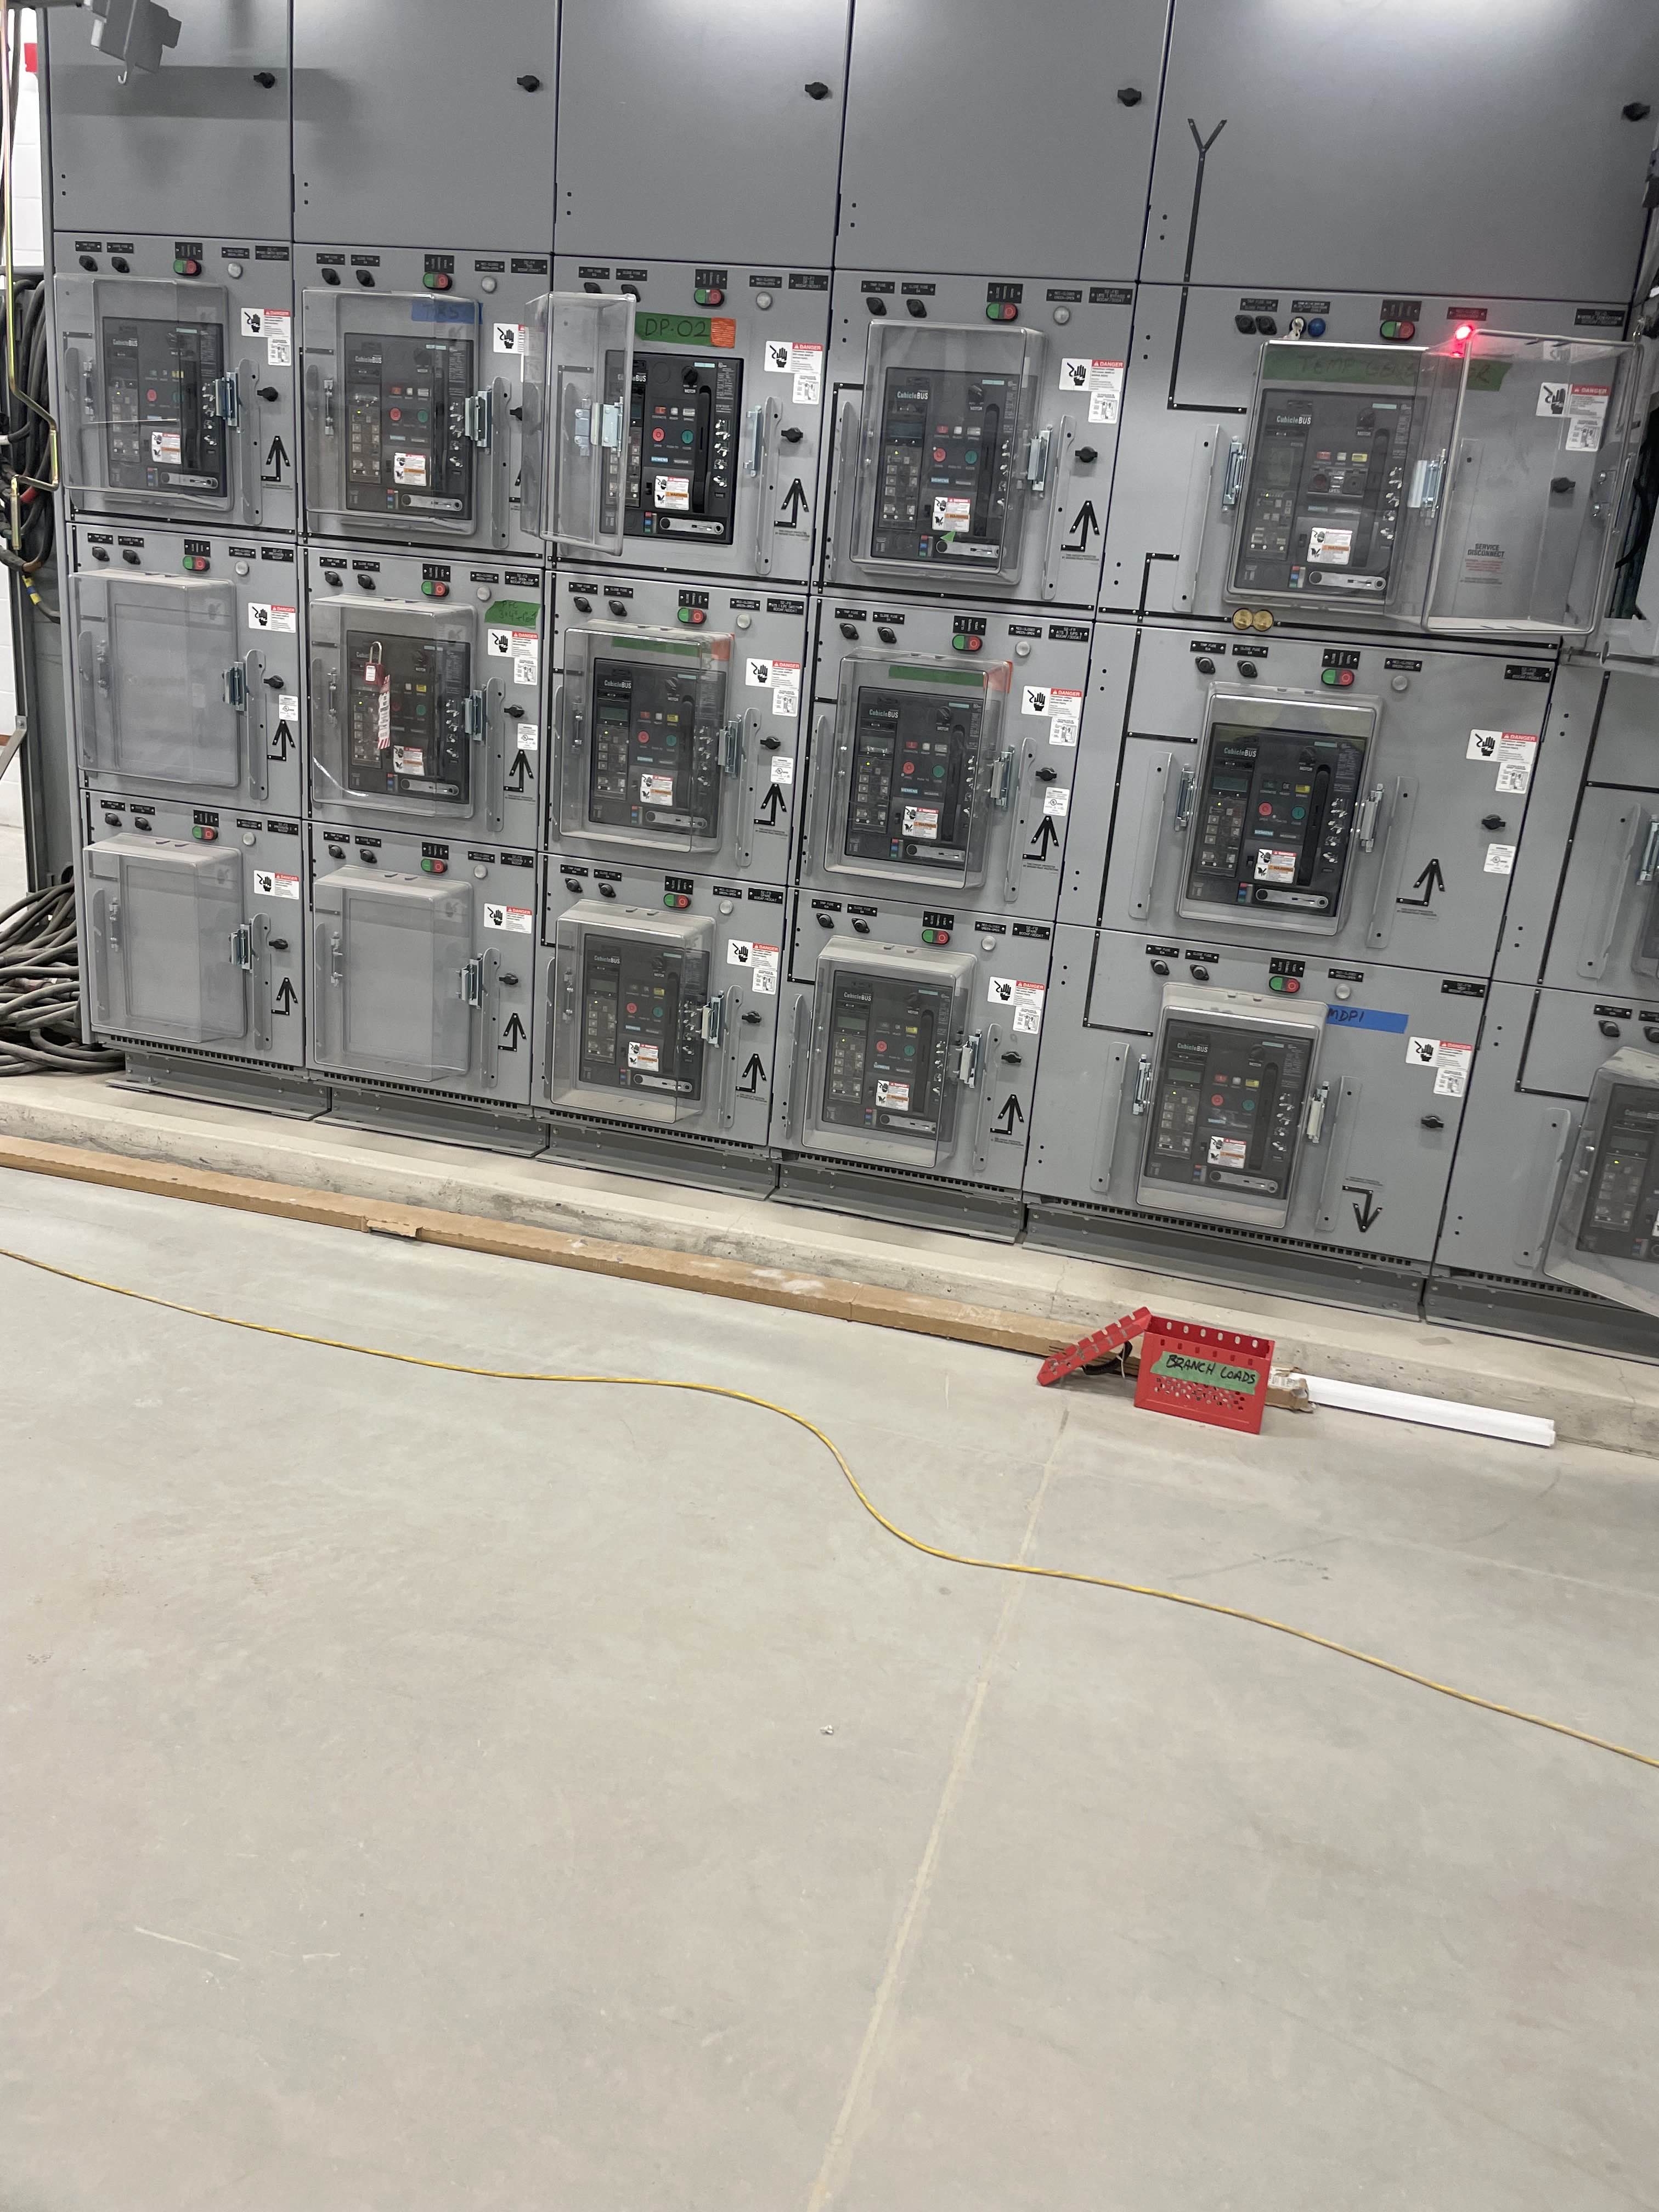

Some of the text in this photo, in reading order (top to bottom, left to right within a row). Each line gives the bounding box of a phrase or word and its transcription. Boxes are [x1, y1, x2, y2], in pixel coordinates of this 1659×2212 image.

[897, 391, 928, 400] CubicleBUS
[1277, 415, 1311, 425] CubicleBUS
[1475, 543, 1499, 551] SERVICE
[1467, 549, 1505, 557] DISCONNECT
[869, 709, 899, 719] CubicleBUS
[1224, 747, 1257, 758] CubicleBUS
[1165, 1354, 1216, 1375] BRANCH
